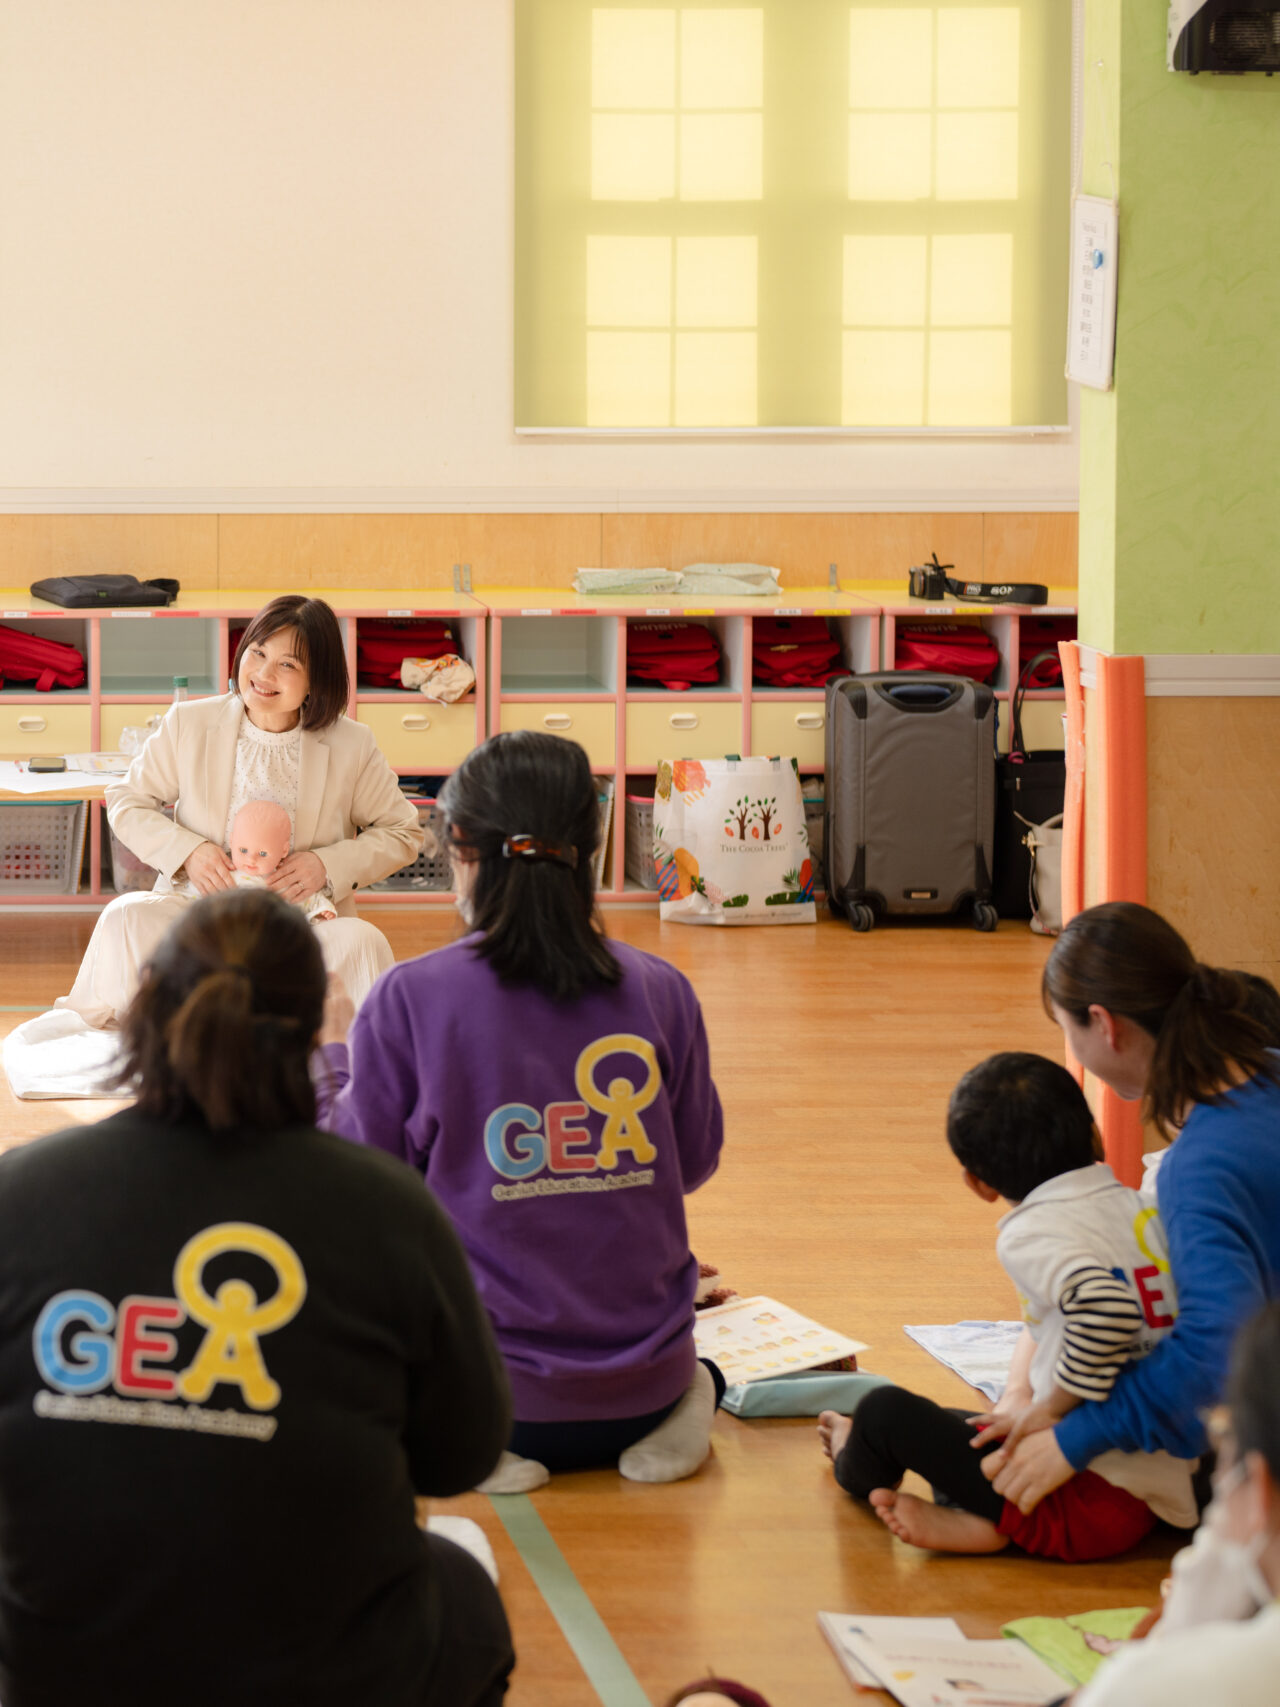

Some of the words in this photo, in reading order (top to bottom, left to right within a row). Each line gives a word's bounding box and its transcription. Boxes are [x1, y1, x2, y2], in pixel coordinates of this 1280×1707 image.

[990, 586, 1015, 595] SON
[484, 1033, 661, 1180] GEA
[32, 1221, 308, 1411] GEA
